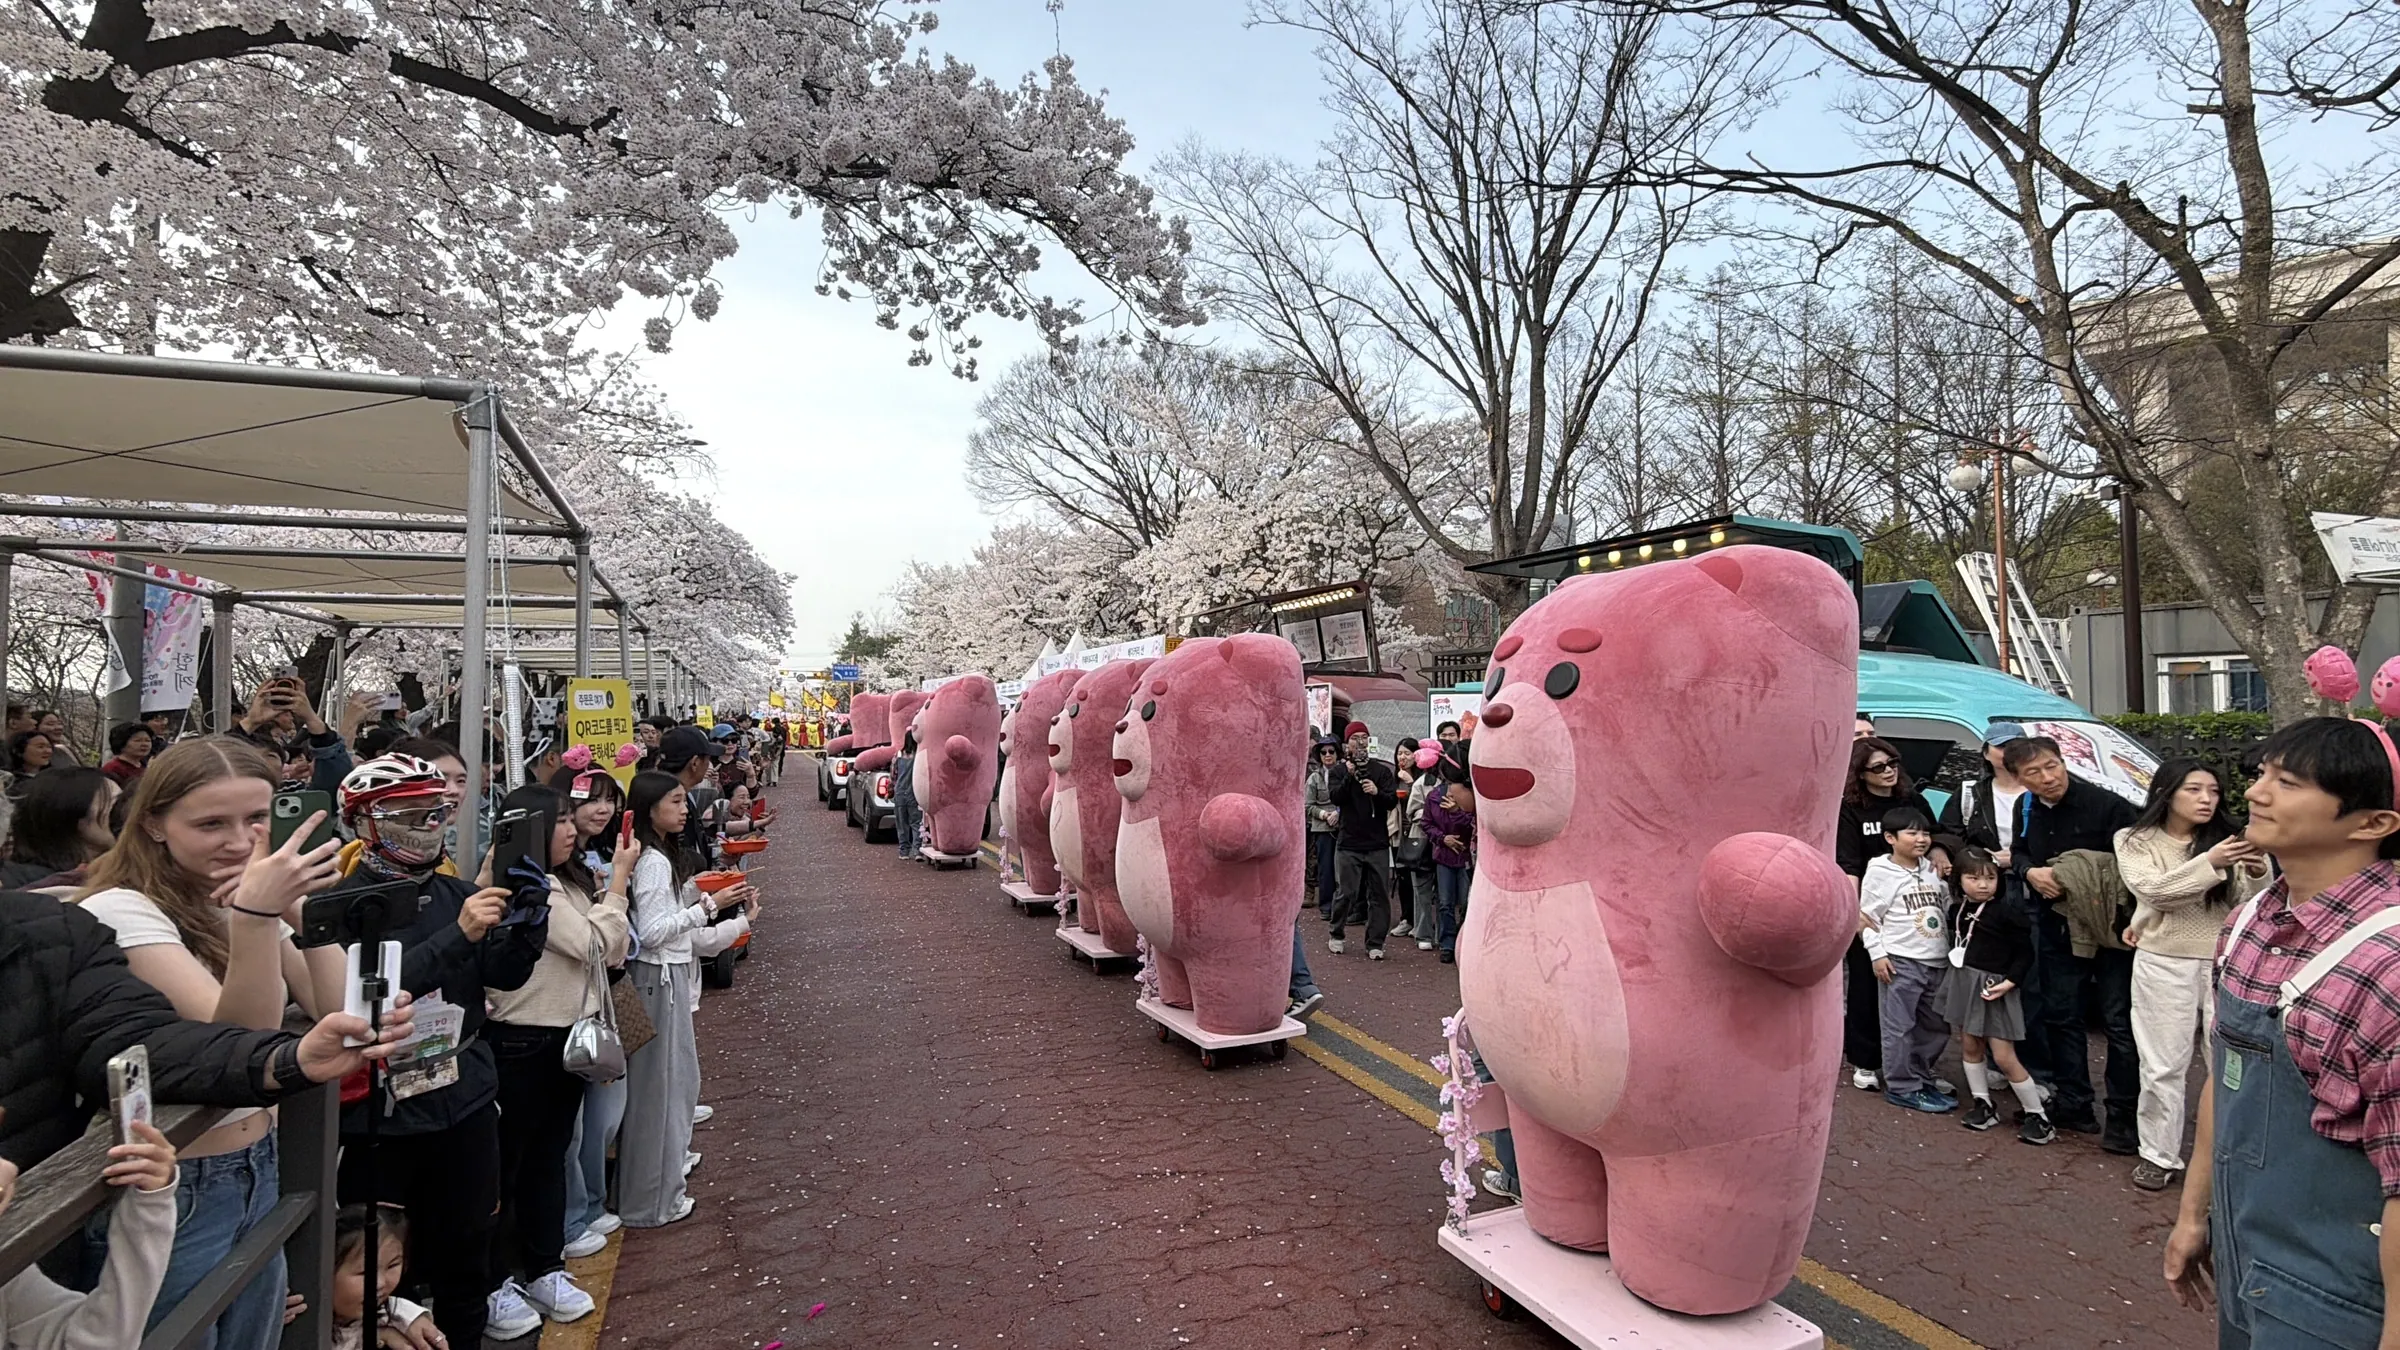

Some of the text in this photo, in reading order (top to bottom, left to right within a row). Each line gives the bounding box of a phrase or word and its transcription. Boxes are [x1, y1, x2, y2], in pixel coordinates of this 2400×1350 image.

[2348, 536, 2400, 553] 시니어클럽
[594, 694, 604, 706] 여기
[575, 718, 628, 738] QR코드를 찍고
[588, 742, 616, 762] 문하세요
